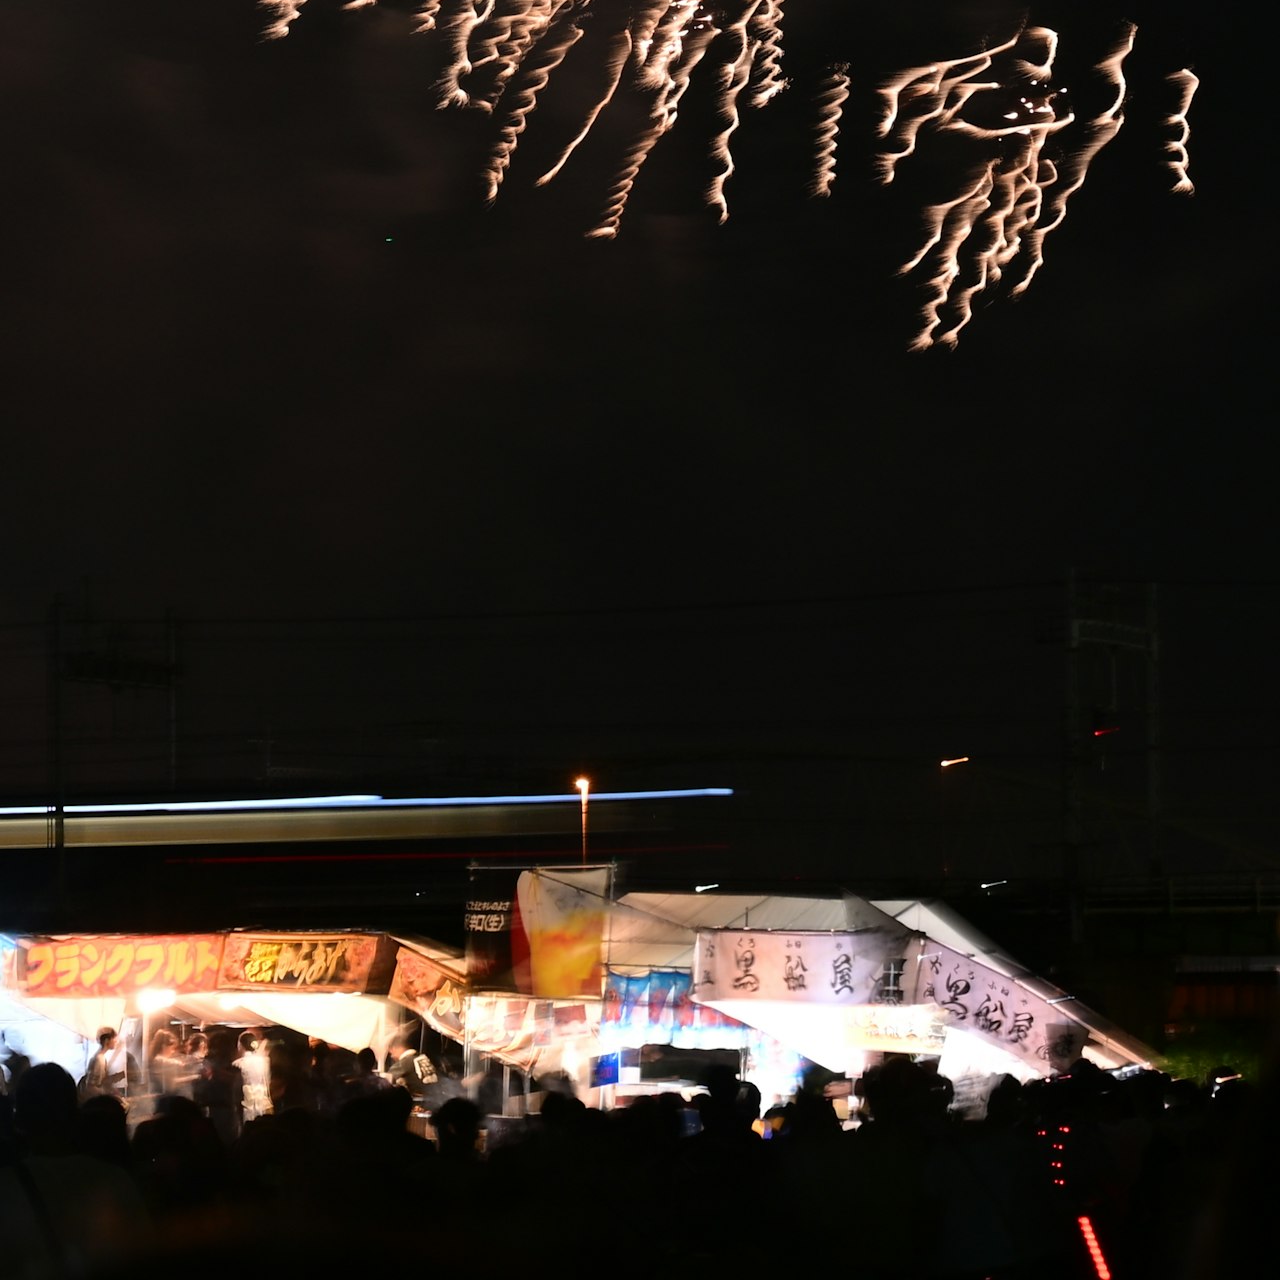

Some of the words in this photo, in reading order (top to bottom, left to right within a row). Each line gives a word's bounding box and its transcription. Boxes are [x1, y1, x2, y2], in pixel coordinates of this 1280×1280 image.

[27, 940, 219, 986] フランクフルト
